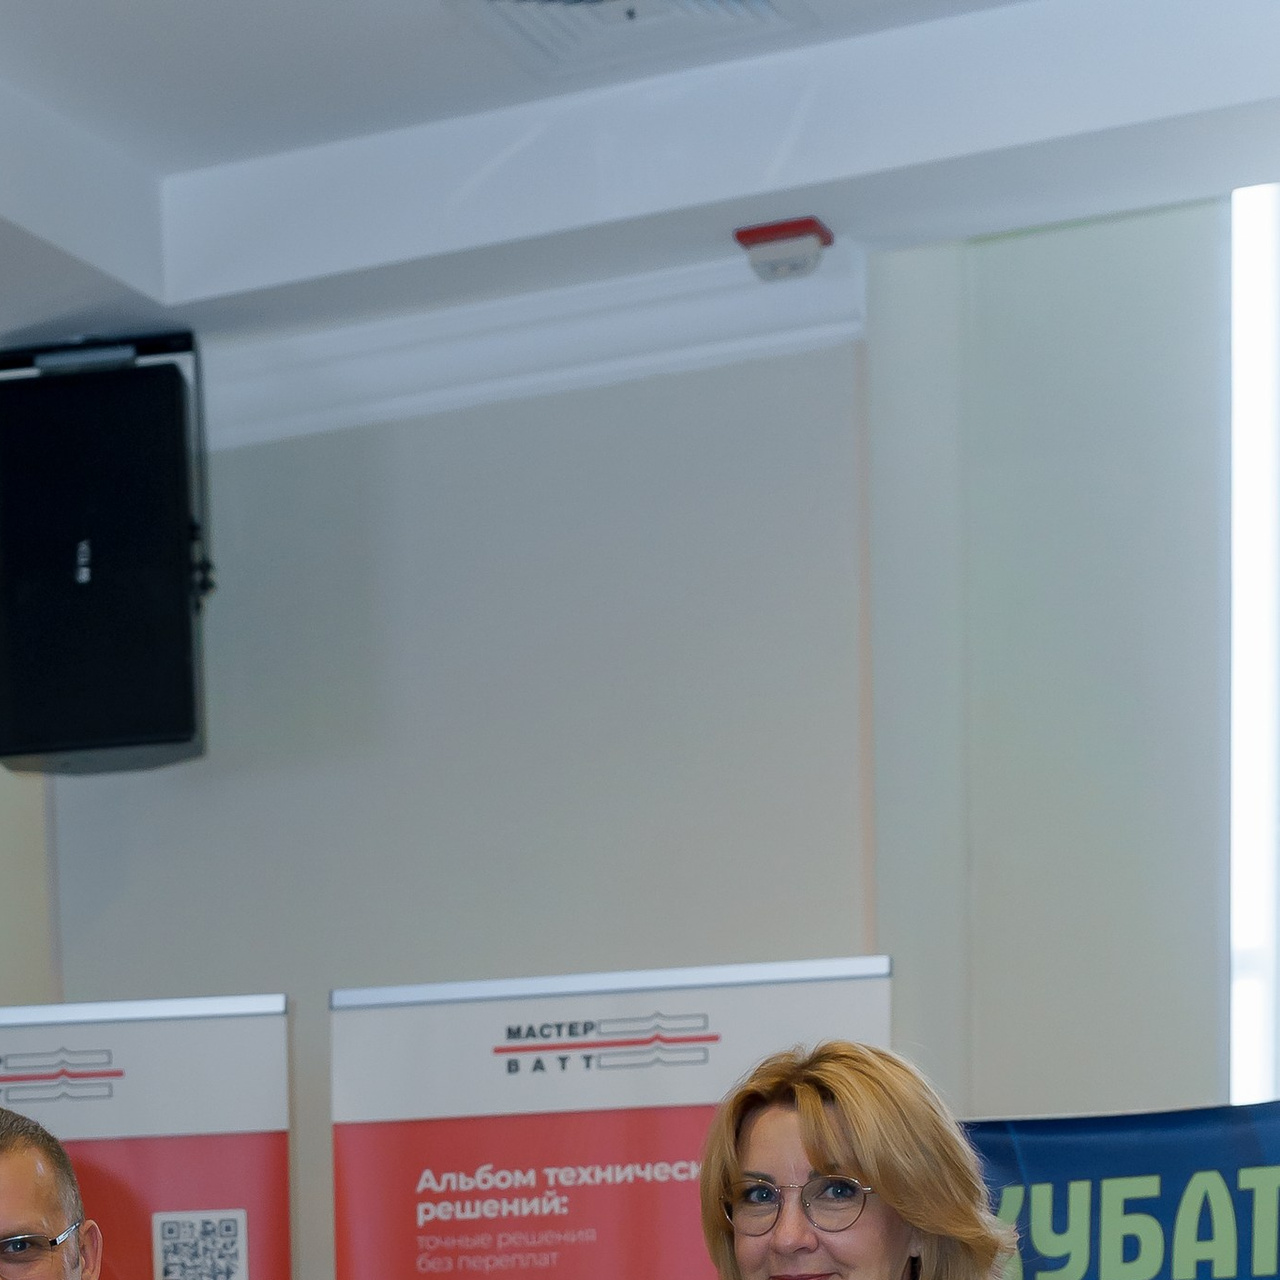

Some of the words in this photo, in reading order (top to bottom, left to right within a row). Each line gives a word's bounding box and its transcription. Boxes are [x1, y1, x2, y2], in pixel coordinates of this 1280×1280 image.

[507, 1022, 594, 1039] МАСТЕР
[507, 1055, 593, 1073] ВАТТ
[416, 1164, 536, 1193] Альбом
[416, 1189, 568, 1227] решений:
[497, 1229, 597, 1250] решения
[416, 1252, 453, 1273] без
